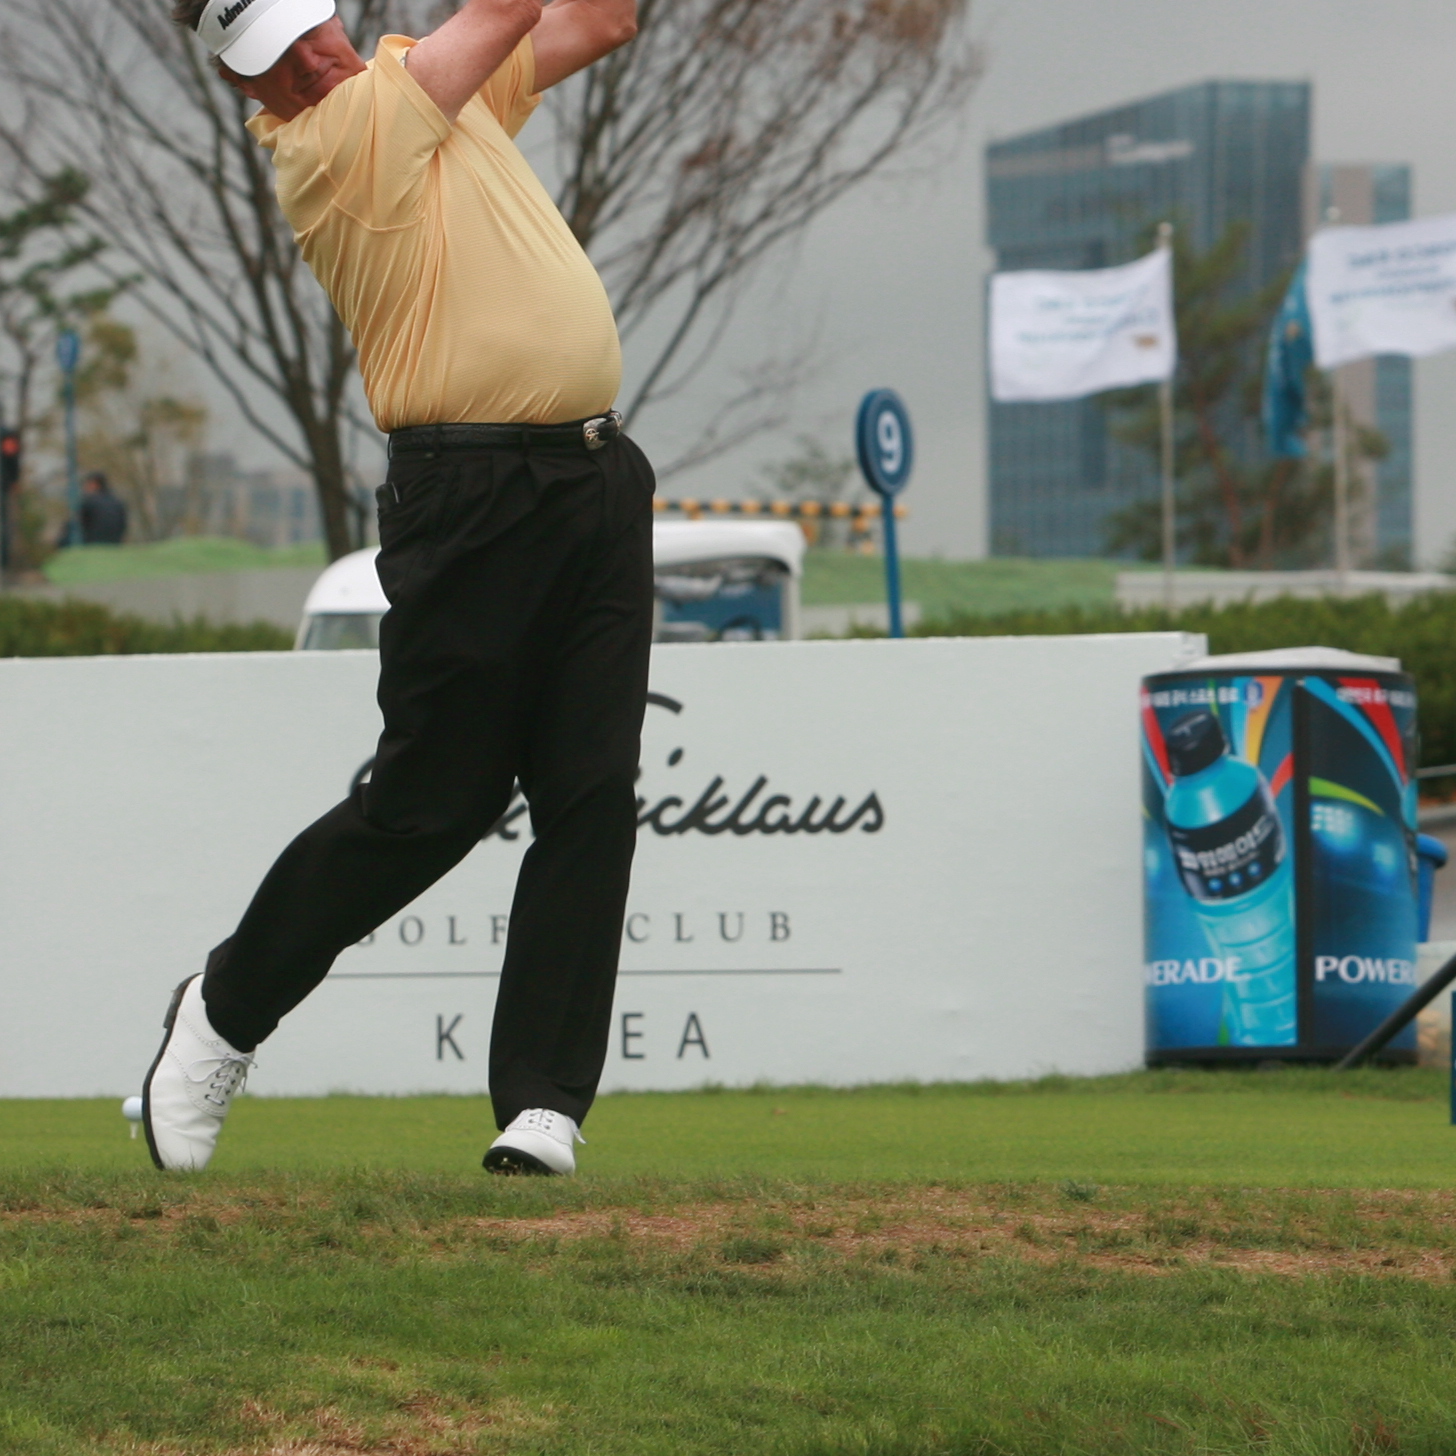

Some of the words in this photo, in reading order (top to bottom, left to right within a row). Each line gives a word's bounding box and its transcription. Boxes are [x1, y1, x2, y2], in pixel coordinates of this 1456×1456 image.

[877, 410, 903, 474] 9
[625, 911, 792, 943] CLUB
[435, 1011, 711, 1061] KEA
